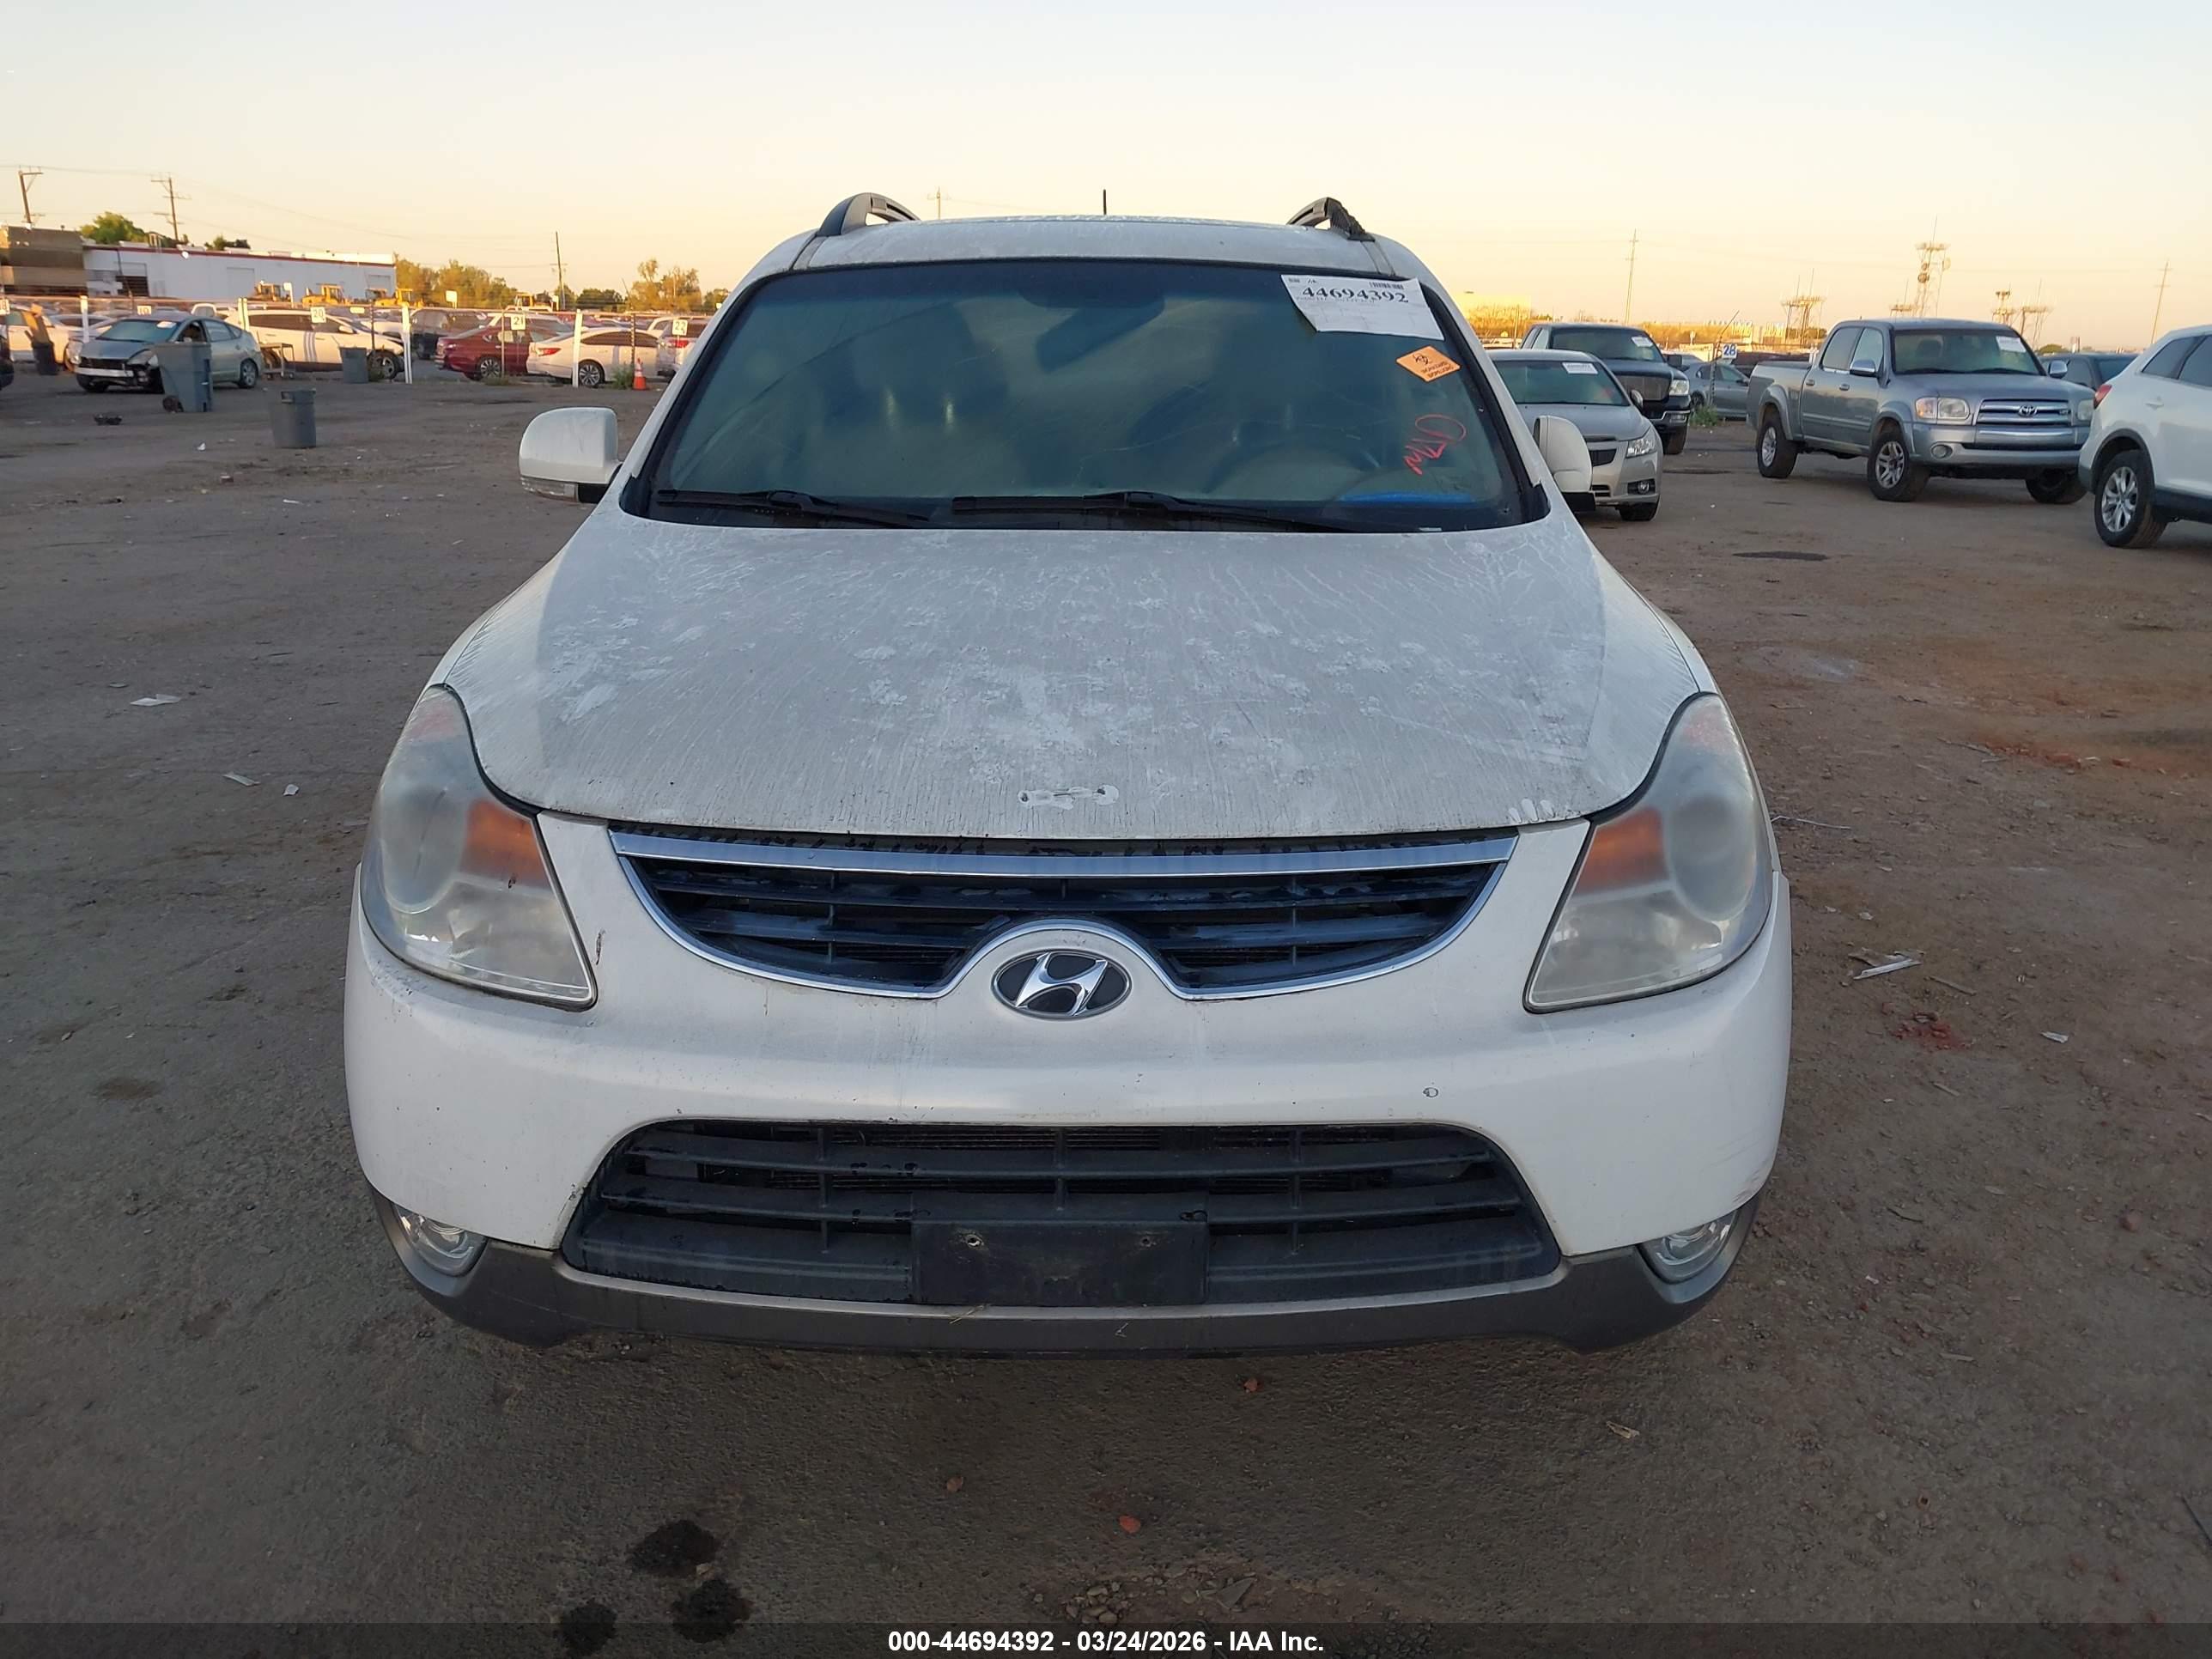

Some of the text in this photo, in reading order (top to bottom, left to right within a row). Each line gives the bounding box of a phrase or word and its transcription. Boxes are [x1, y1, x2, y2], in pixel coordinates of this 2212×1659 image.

[1302, 286, 1409, 303] 44694392
[313, 309, 325, 319] 20
[513, 316, 524, 325] 21
